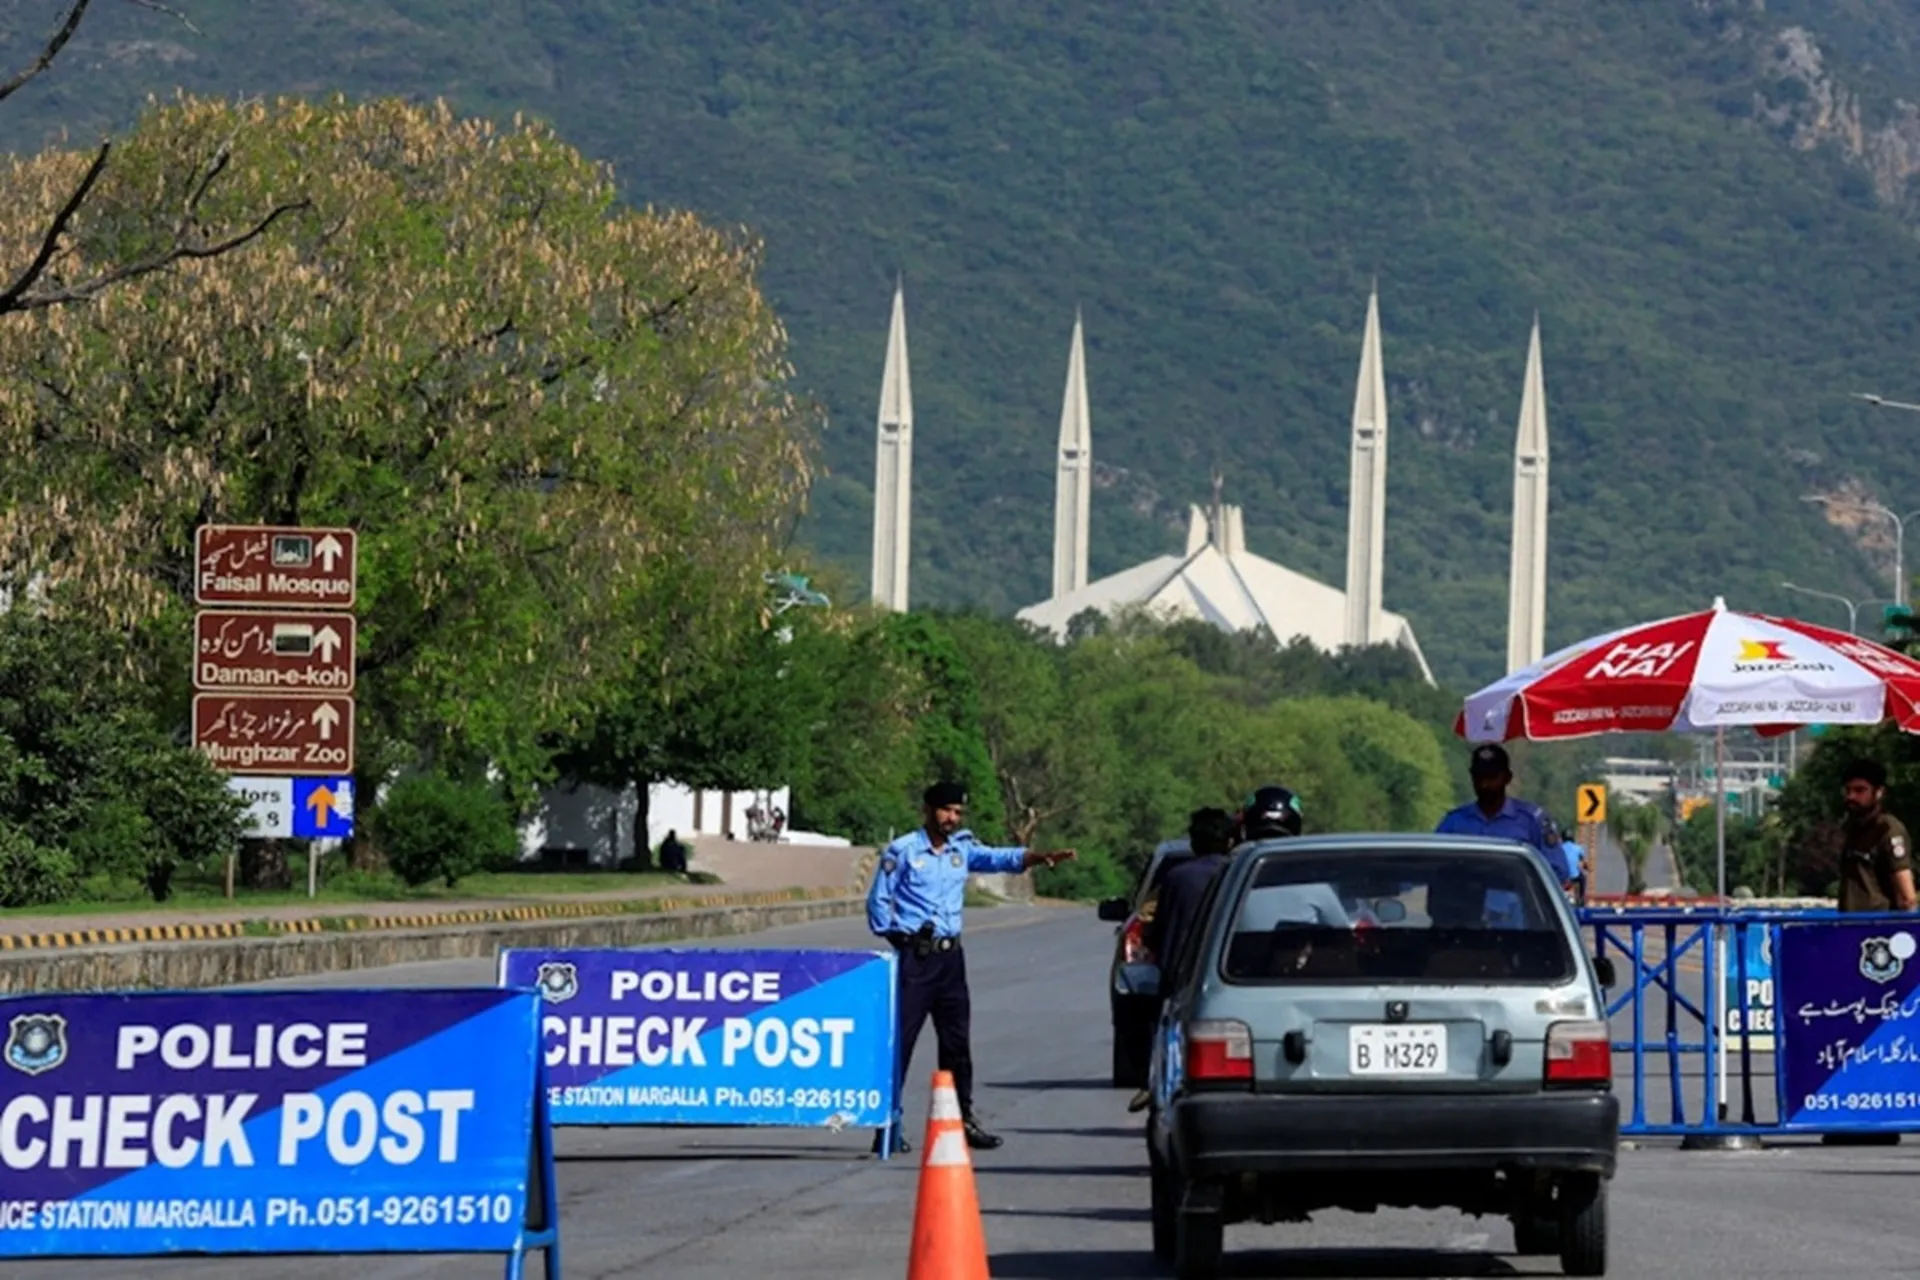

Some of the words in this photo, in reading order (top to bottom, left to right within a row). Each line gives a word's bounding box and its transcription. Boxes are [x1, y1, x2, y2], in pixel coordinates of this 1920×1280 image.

[201, 572, 262, 593] Faisal
[267, 573, 350, 598] Mosque
[201, 662, 348, 685] Daman-e-koh
[200, 741, 299, 766] Murghzar
[303, 743, 347, 763] Zoo
[611, 970, 781, 1001] POLICE
[116, 1022, 369, 1070] POLICE
[543, 1016, 708, 1066] CHECK
[722, 1017, 855, 1068] POST
[1357, 1042, 1372, 1070] B
[564, 1086, 624, 1107] STATION
[626, 1086, 709, 1107] MARGALLA
[714, 1086, 882, 1110] Ph.051-9261510
[1803, 1092, 1920, 1111] 051-926151
[0, 1094, 256, 1170] CHECK
[278, 1088, 475, 1166] POST
[0, 1201, 37, 1230] ICE
[40, 1200, 132, 1230] STATION
[134, 1198, 256, 1229] MARGALLA
[265, 1195, 512, 1228] Ph.051-9261510
